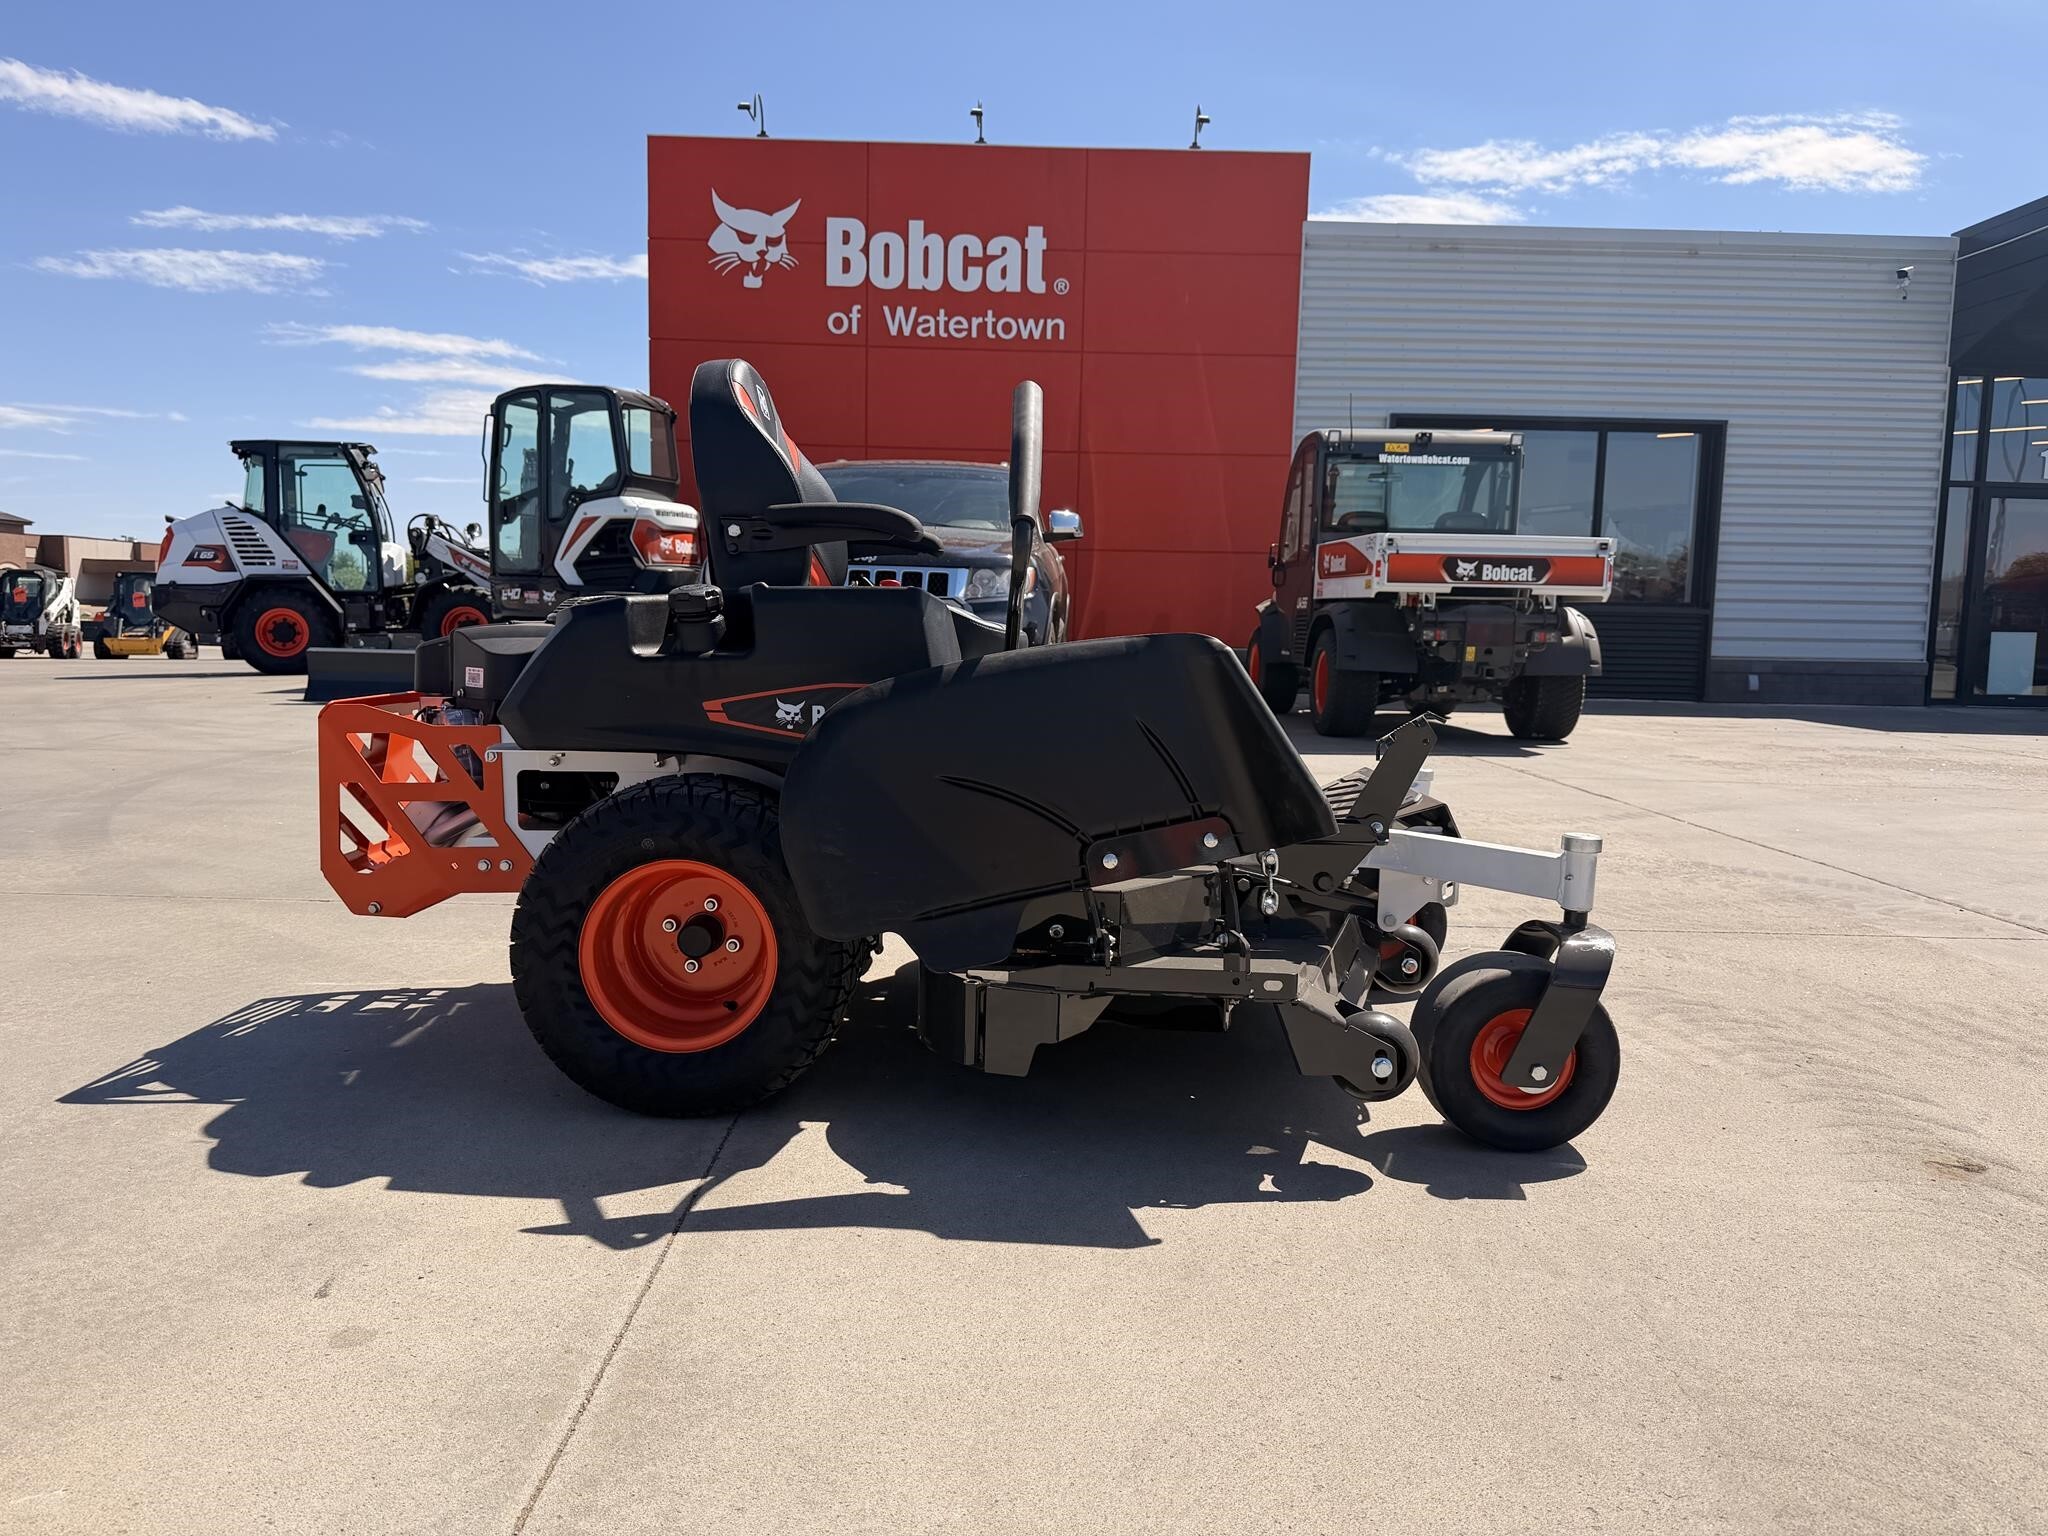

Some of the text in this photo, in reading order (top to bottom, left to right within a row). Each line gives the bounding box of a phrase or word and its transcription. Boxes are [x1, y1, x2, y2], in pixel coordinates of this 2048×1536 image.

[827, 304, 1066, 341] of Watertown
[1378, 453, 1471, 465] WatertownBobcat.com
[1482, 564, 1534, 581] Bobcat
